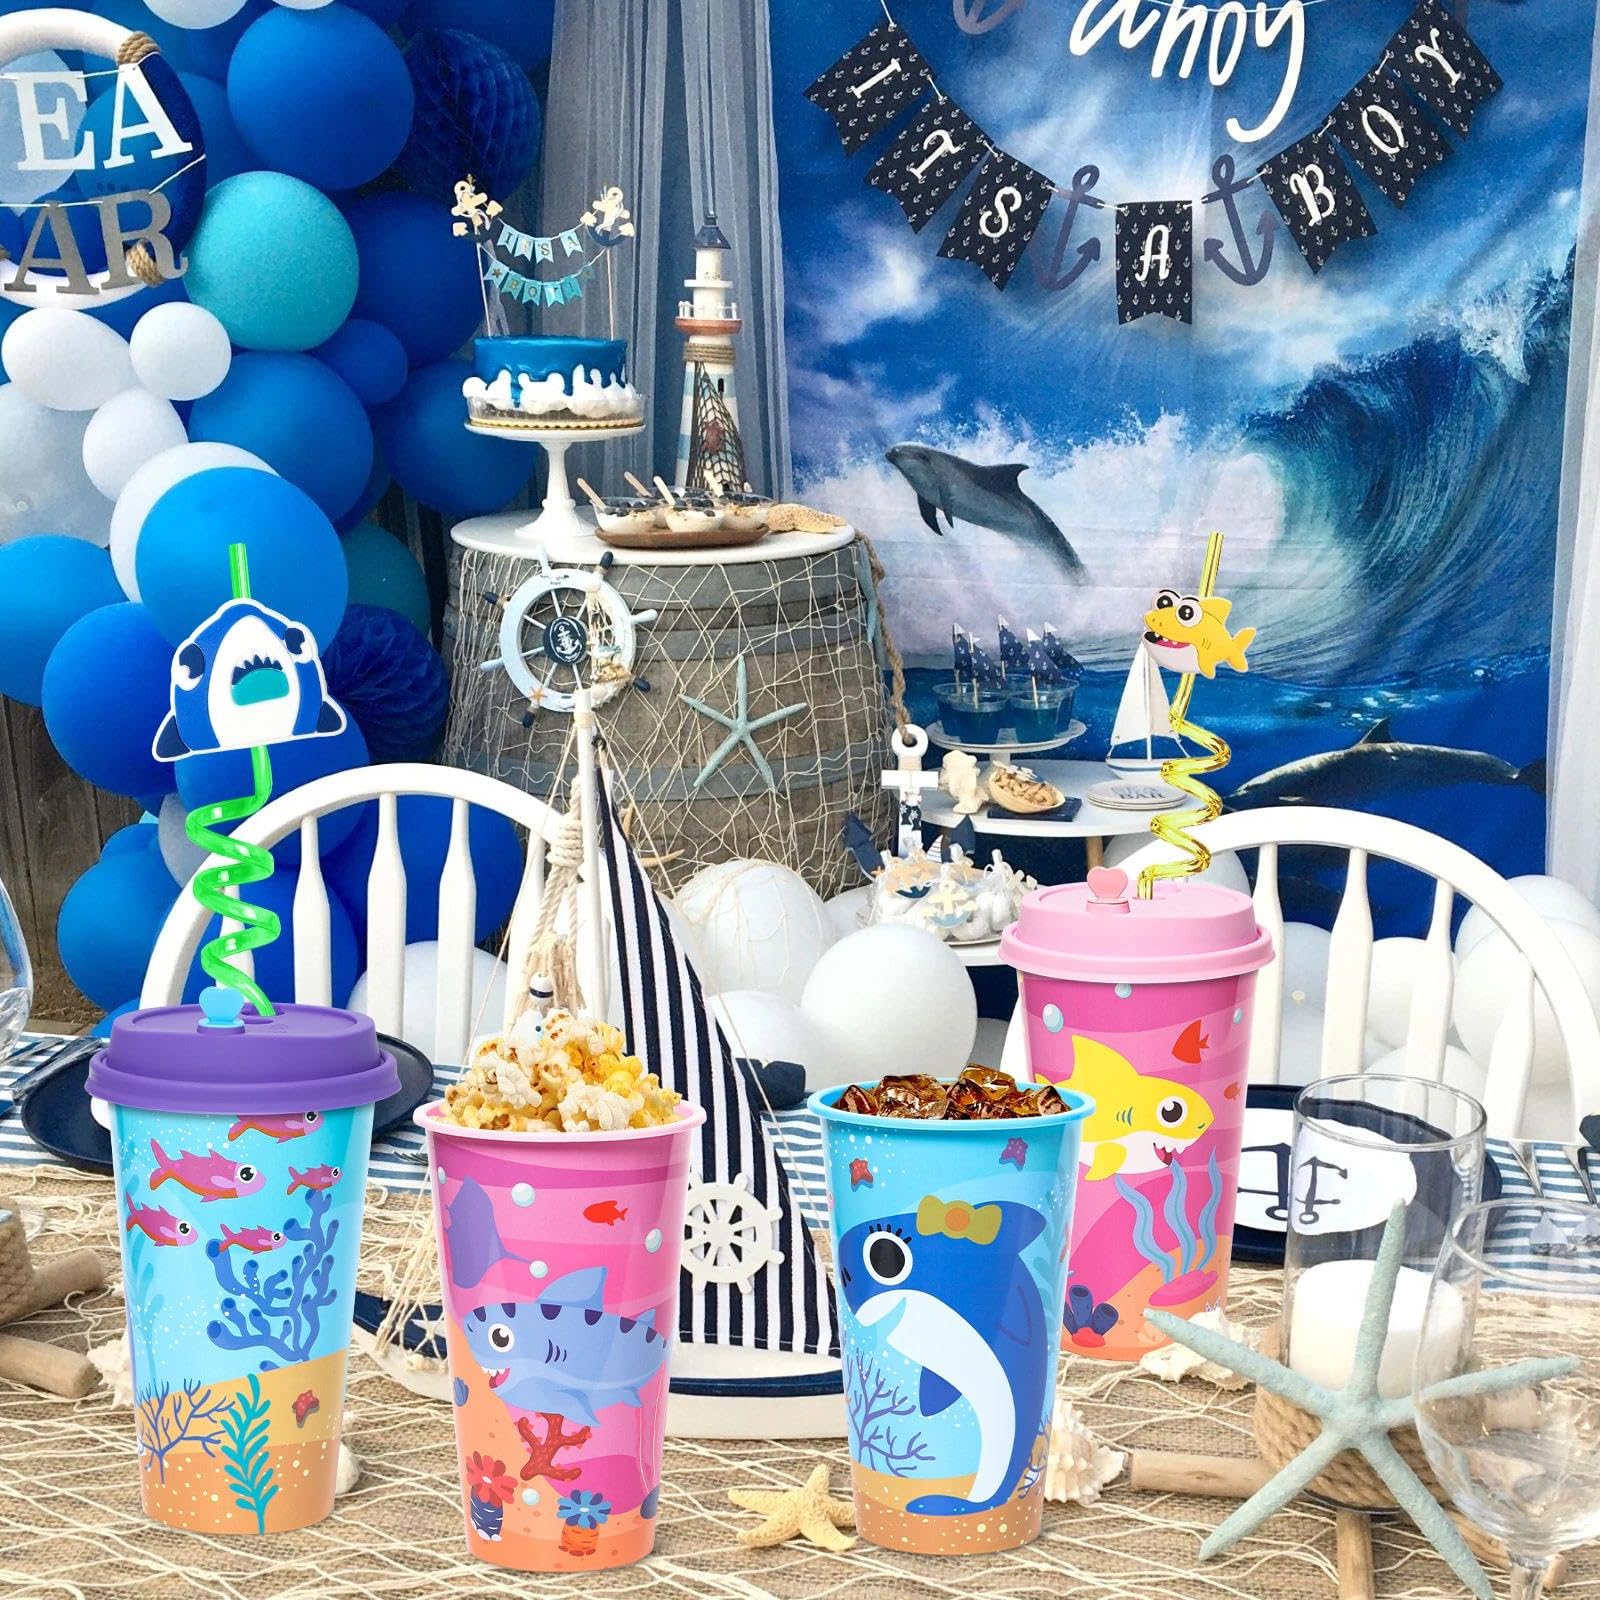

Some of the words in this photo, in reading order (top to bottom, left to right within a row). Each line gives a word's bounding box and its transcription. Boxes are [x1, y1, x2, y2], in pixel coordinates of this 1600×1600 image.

[850, 57, 1023, 238] ITS
[1135, 224, 1170, 282] A
[1289, 27, 1462, 227] BOY
[1069, 0, 1306, 143] ahoy
